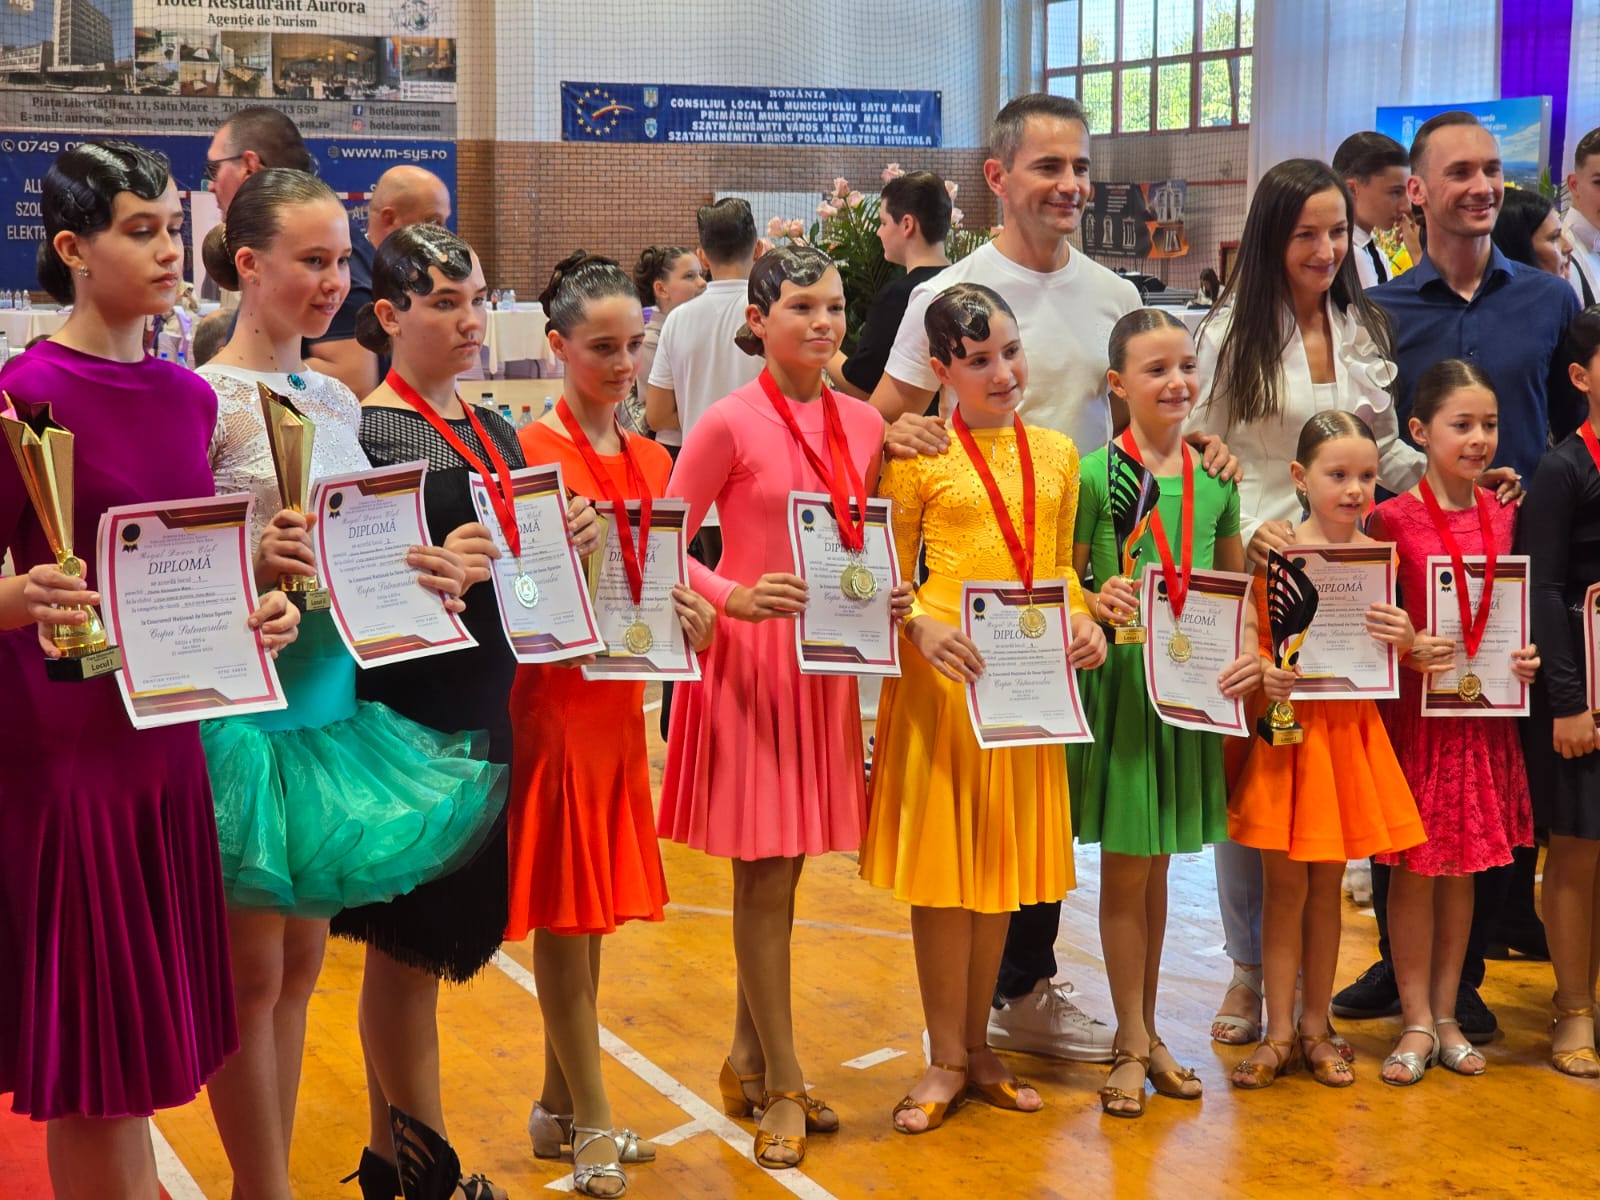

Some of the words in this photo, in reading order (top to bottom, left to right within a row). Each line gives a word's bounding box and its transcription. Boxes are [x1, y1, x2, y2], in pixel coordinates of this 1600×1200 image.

[307, 0, 366, 14] Aurora
[257, 14, 271, 26] de
[273, 15, 318, 28] Turism
[153, 101, 178, 111] Satu
[180, 102, 209, 112] Mare
[670, 98, 727, 109] CONSILIUL
[731, 99, 763, 110] LOCAL
[766, 101, 780, 110] AL
[784, 101, 856, 112] MUNICIPIULUI
[861, 102, 887, 112] SATU
[892, 103, 921, 113] MARE
[758, 111, 829, 122] MUNICIPIULUI
[832, 112, 858, 123] SATU
[863, 113, 892, 123] MARE
[786, 120, 819, 132] VÁROS
[823, 122, 853, 133] HELYI
[18, 140, 60, 153] 0749
[884, 135, 932, 146] HIVATALA
[341, 147, 448, 161] www.m-sys.ro
[24, 178, 44, 193] ALL
[16, 201, 44, 217] SZOL
[7, 225, 47, 240] ELEKTR
[348, 518, 397, 539] DIPLOMĂ
[148, 553, 212, 575] DIPLOMĂ
[1179, 613, 1217, 627] IPLOMĂ
[993, 629, 1029, 640] DIPLO
